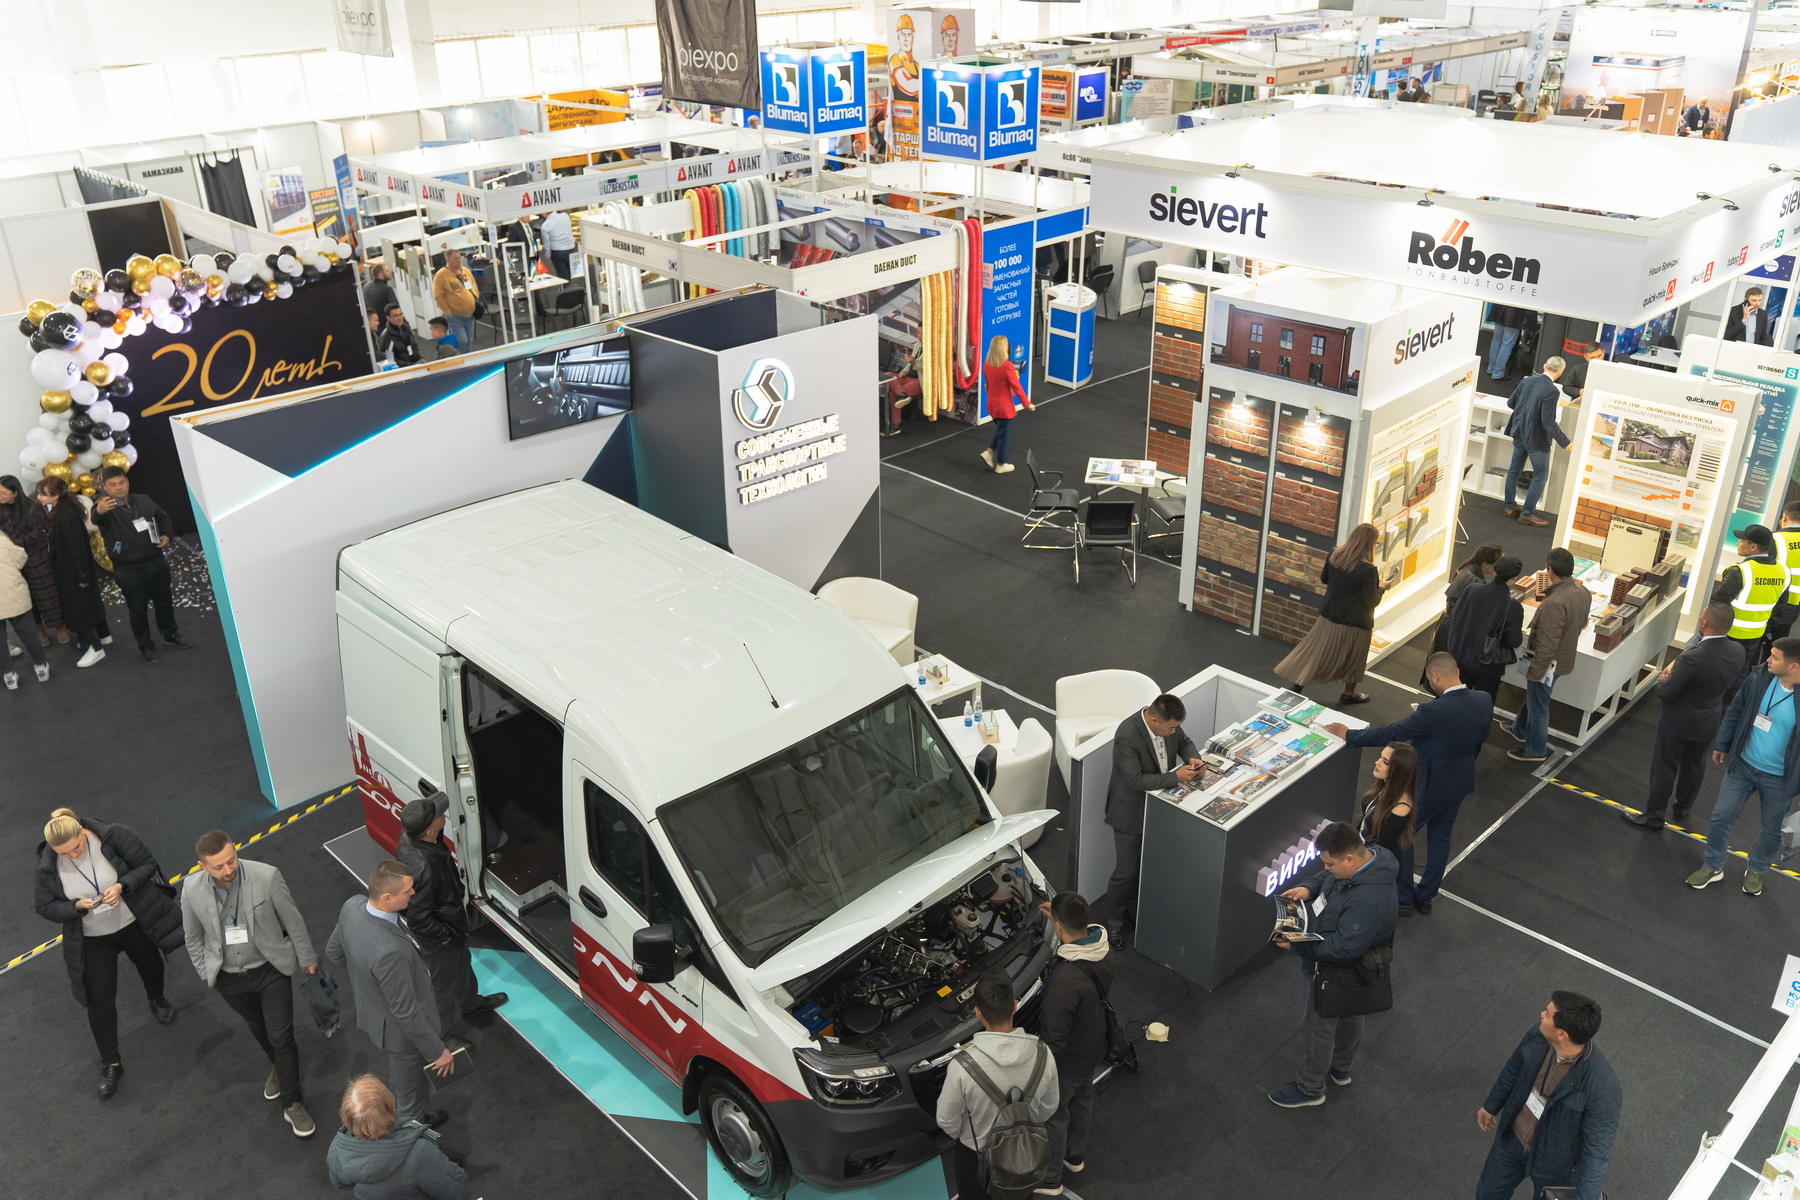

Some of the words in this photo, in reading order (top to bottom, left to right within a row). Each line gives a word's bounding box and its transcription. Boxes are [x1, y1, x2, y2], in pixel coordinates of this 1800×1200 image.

[549, 110, 599, 120] ОБСТВЕННОСТЬ
[767, 104, 808, 128] Blumaq
[818, 106, 863, 123] Blumaq
[927, 126, 977, 152] Blumaq
[989, 128, 1034, 147] Blumaq
[688, 162, 713, 180] AVANT
[737, 154, 761, 173] AVANT
[363, 169, 379, 187] AVANT
[393, 175, 410, 195] AVANT
[603, 179, 639, 194] UZBEKISTAN
[428, 185, 446, 204] AVANT
[462, 193, 481, 213] AVANT
[533, 187, 562, 207] AVANT
[879, 210, 897, 219] DAEHAN
[1149, 185, 1268, 239] sievert
[611, 238, 631, 253] DAEHAN
[631, 244, 646, 256] DUCT
[999, 243, 1017, 254] БОЛЕЕ
[1407, 218, 1541, 285] Röben
[874, 258, 899, 274] DAEHAN
[900, 254, 917, 268] DUCT
[994, 257, 1008, 270] 100
[1008, 254, 1022, 267] 000
[1648, 265, 1662, 277] Наши
[992, 265, 1031, 283] ИМЕНОВАНИЙ
[1405, 266, 1538, 297] TONBAUSTOFFE
[993, 279, 1022, 294] ЗАПАСНЫХ
[997, 290, 1018, 302] ЧАСТЕЙ
[1642, 288, 1666, 309] quick-mix
[995, 301, 1020, 314] ГОТОВЫХ
[992, 317, 996, 325] К
[997, 310, 1022, 325] ОТГРУЗКЕ
[1394, 311, 1456, 366] sievert
[140, 329, 257, 418] 20
[1756, 364, 1785, 374] strasser
[1759, 382, 1786, 393] УКЛАДКА
[1686, 394, 1720, 407] quick-mix
[1684, 420, 1724, 433] МАТЕРИАЛОМ
[1694, 416, 1713, 425] РИСКА
[735, 413, 840, 460] СОВРЕМЕННЫЕ
[736, 433, 847, 483] ТРАНСПОРТНЫЕ
[737, 462, 828, 506] ТЕХНОЛОГИИ
[1754, 577, 1785, 587] SECURITY
[1258, 832, 1327, 897] ВИРА
